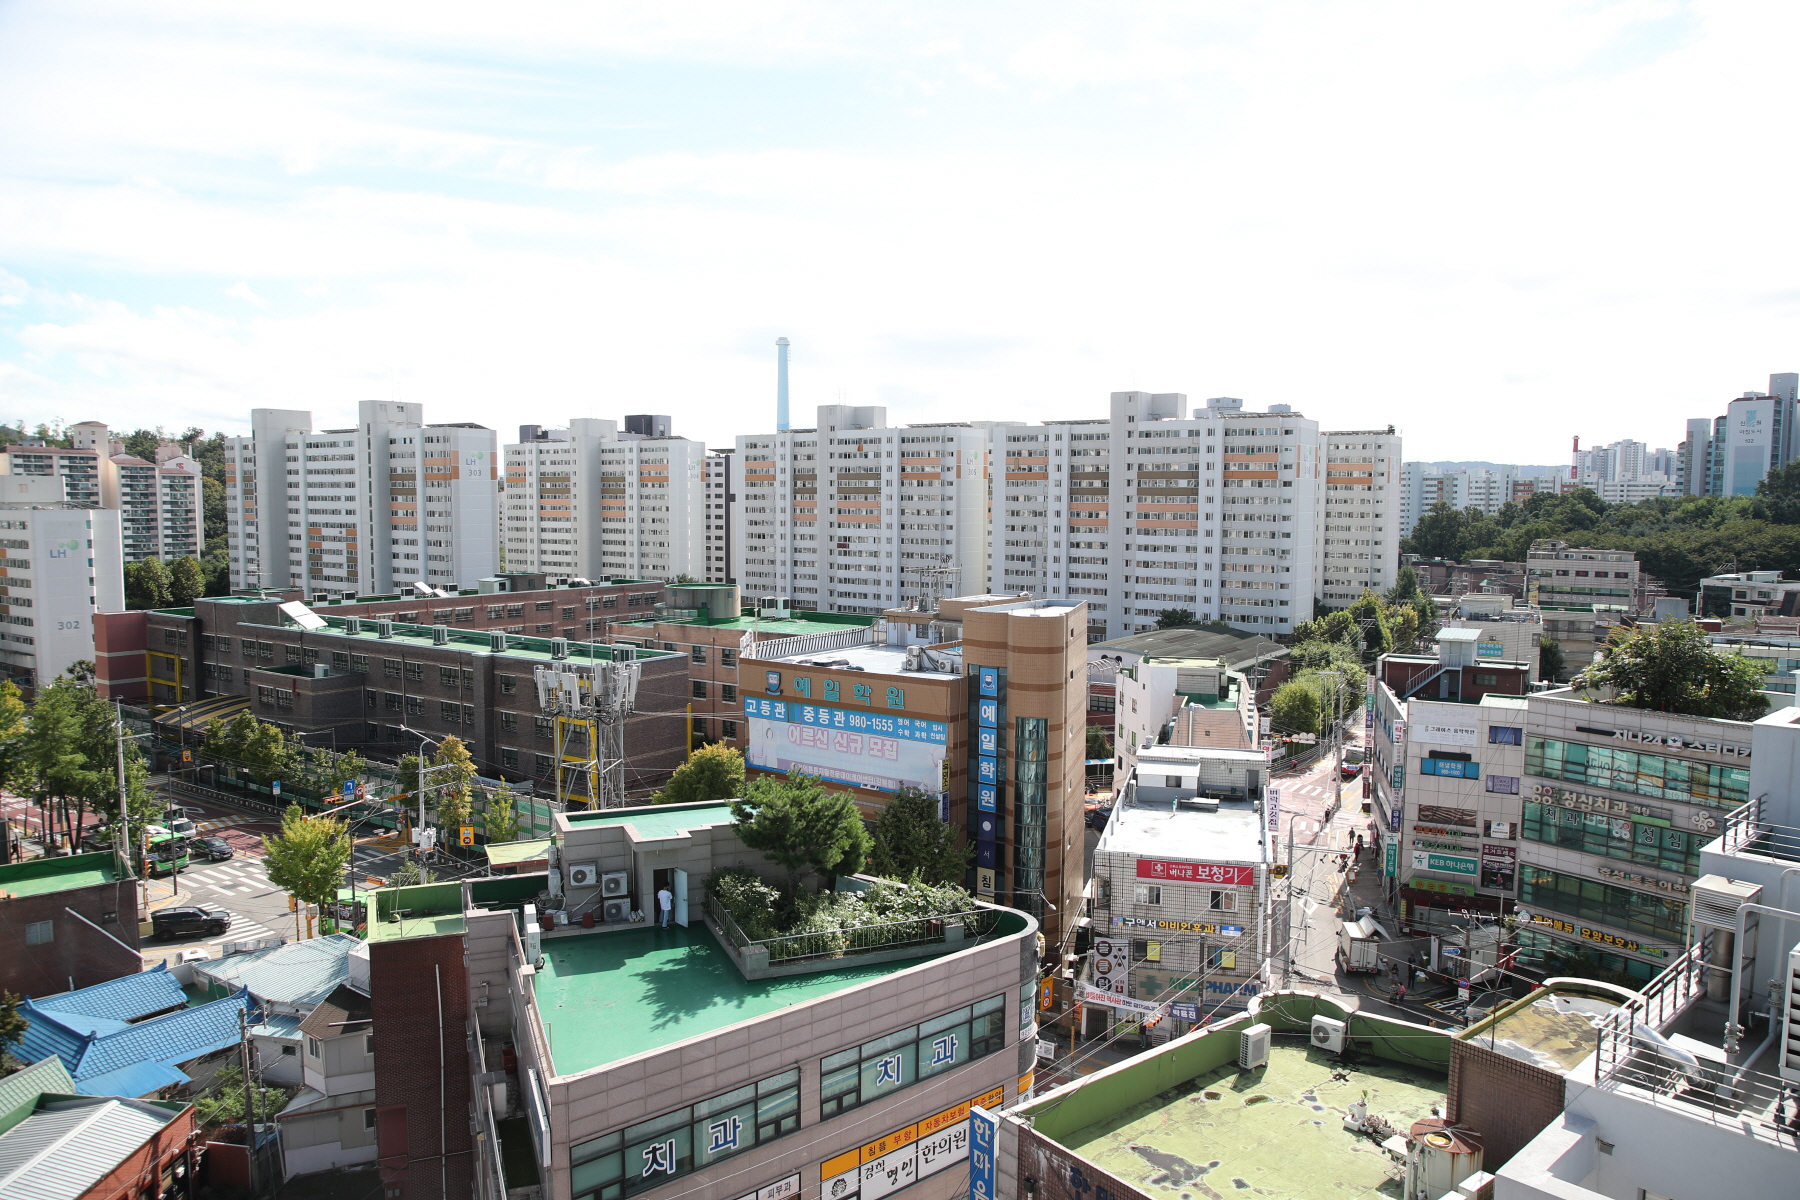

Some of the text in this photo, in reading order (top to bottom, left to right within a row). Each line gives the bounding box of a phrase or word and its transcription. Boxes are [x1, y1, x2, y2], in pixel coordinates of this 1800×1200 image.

[465, 458, 476, 466] LH
[966, 457, 974, 465] LH
[468, 469, 482, 477] 303
[49, 549, 67, 559] LH
[57, 620, 80, 631] 302
[794, 677, 905, 710] 예일학원
[746, 699, 893, 733] 고등관 중등관 980-1555
[897, 718, 910, 727] 영어
[914, 719, 927, 729] 국어
[897, 728, 910, 738] 수학
[914, 731, 927, 740] 과학
[1612, 729, 1663, 747] 지니24
[788, 725, 899, 762] 어르신 신규 모집
[980, 705, 995, 807] 예일학원
[1562, 791, 1629, 816] 성심치과
[1544, 806, 1579, 826] 치과
[1430, 858, 1475, 872] KEB 하나은행
[982, 875, 991, 888] 침
[1169, 866, 1238, 883] 버나폰 보청기
[1124, 917, 1157, 929] 구앤서
[1158, 920, 1216, 934] 이비인후과
[1580, 927, 1639, 953] 요양보호사
[1172, 1008, 1197, 1020] 박용진
[877, 1034, 958, 1086] 치과
[868, 1141, 887, 1158] 침뜸
[893, 1130, 913, 1146] 부항
[925, 1106, 966, 1131] 자동차보험
[643, 1115, 743, 1177] 치과
[864, 1128, 968, 1186] 경희 명인 한의원
[972, 1117, 991, 1200] 한마음
[766, 1180, 793, 1199] 피부과
